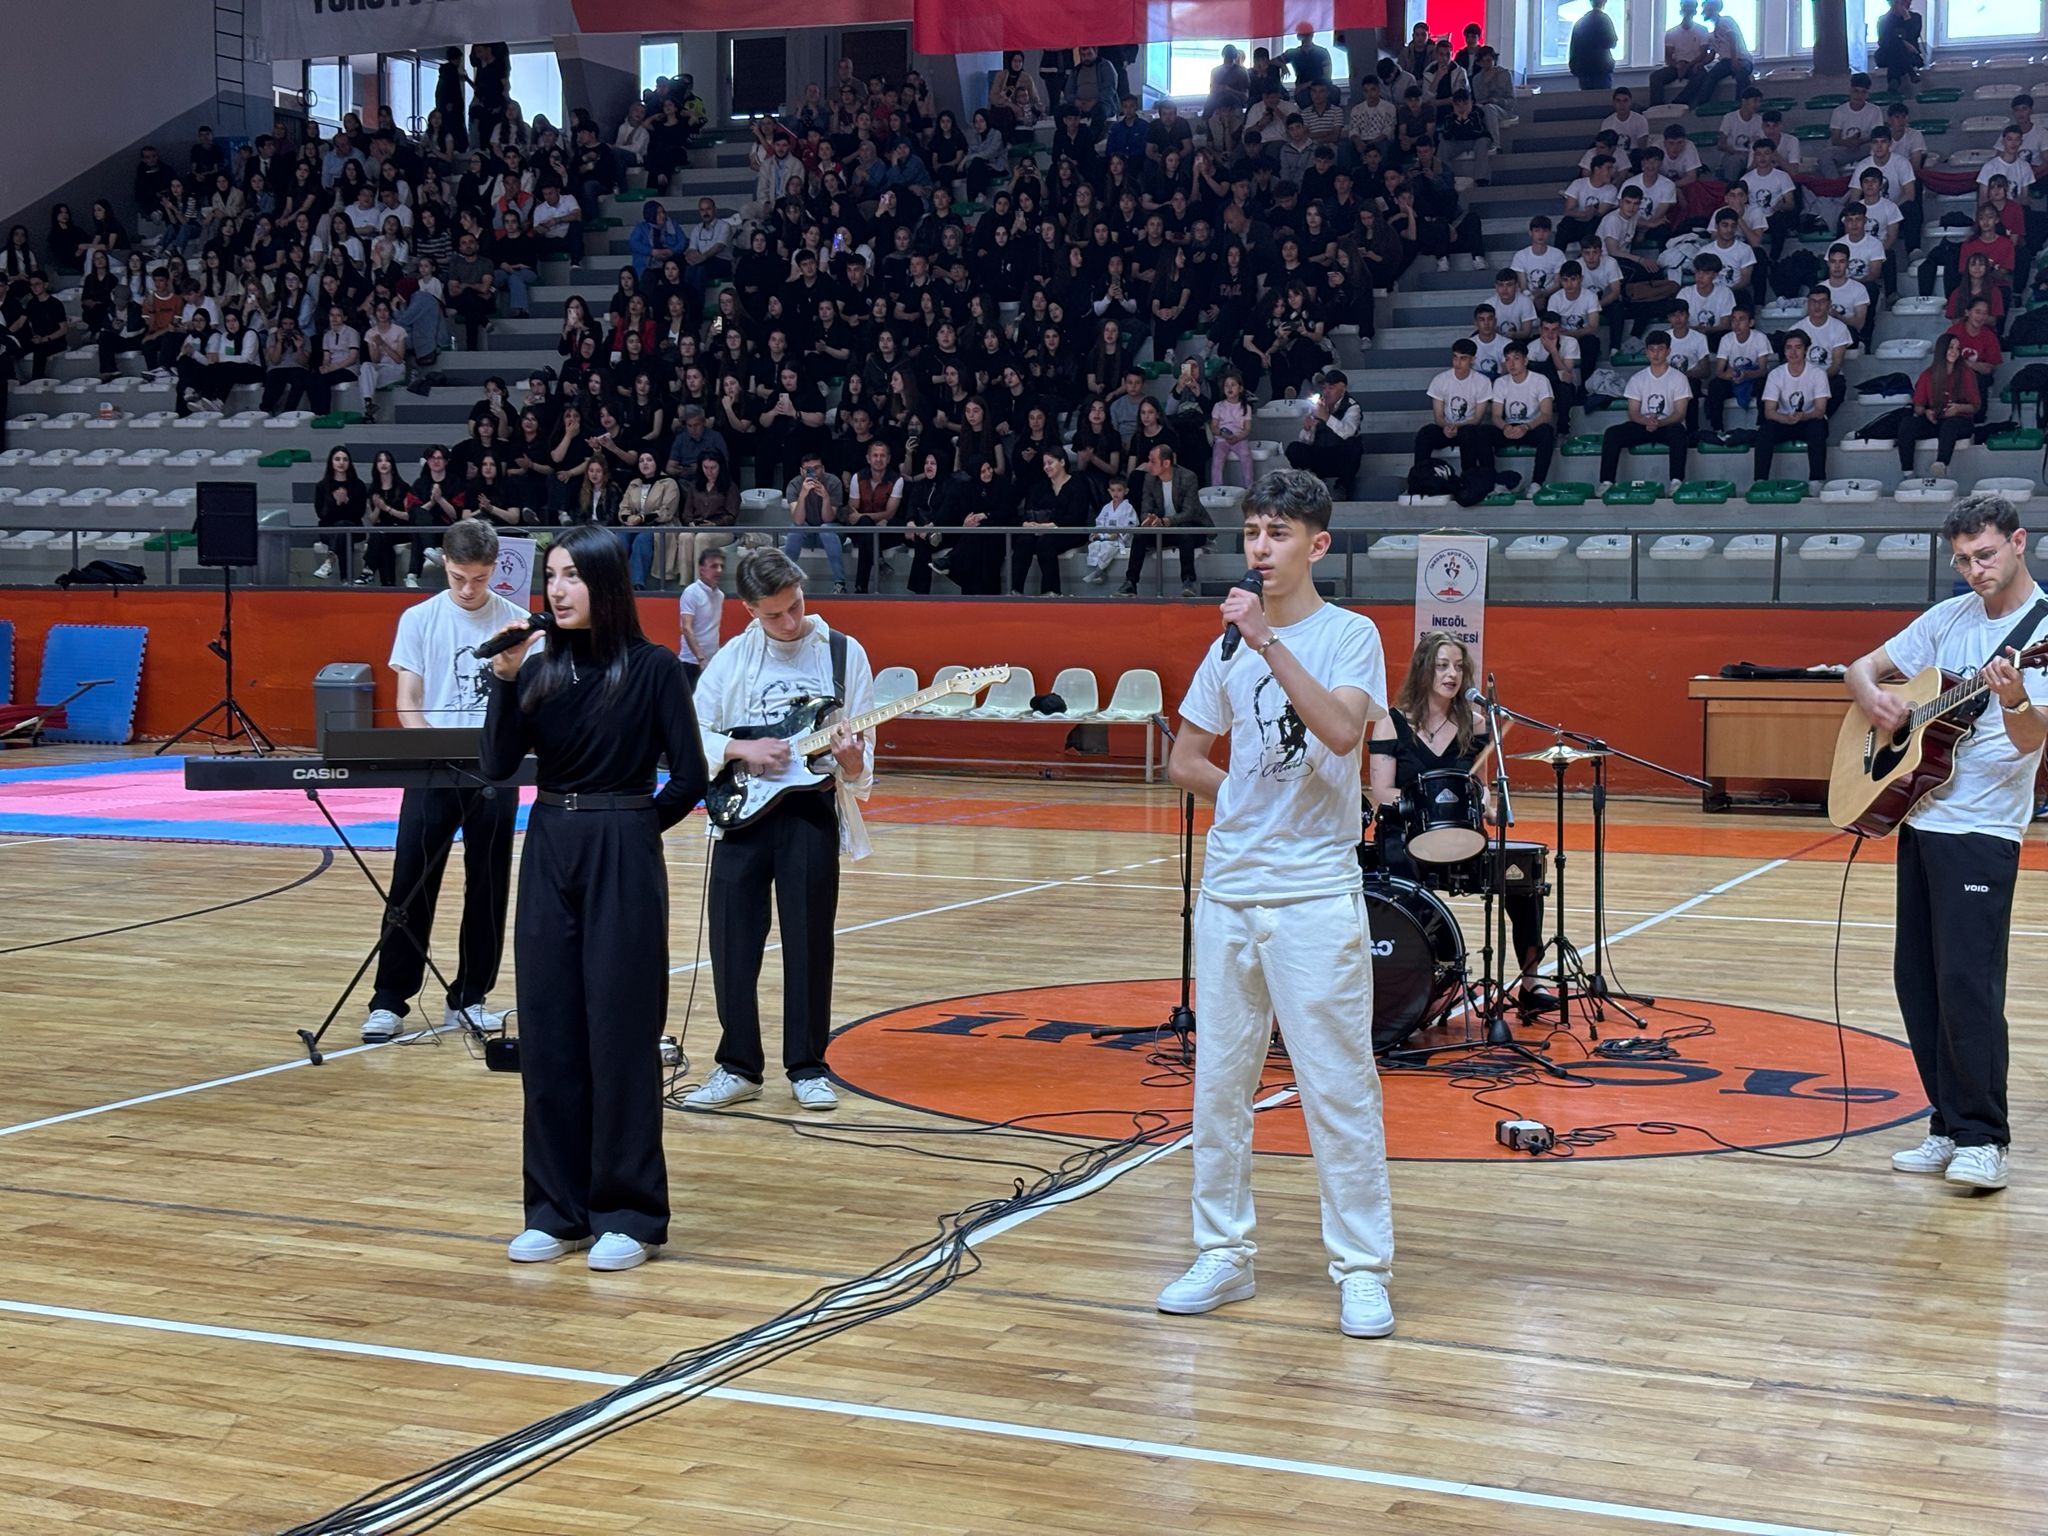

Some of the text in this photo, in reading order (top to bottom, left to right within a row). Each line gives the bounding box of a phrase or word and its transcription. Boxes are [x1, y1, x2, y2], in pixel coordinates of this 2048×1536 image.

[1431, 613, 1467, 628] İNEGÖL
[293, 768, 349, 780] CASIO
[1964, 884, 1990, 893] VOID
